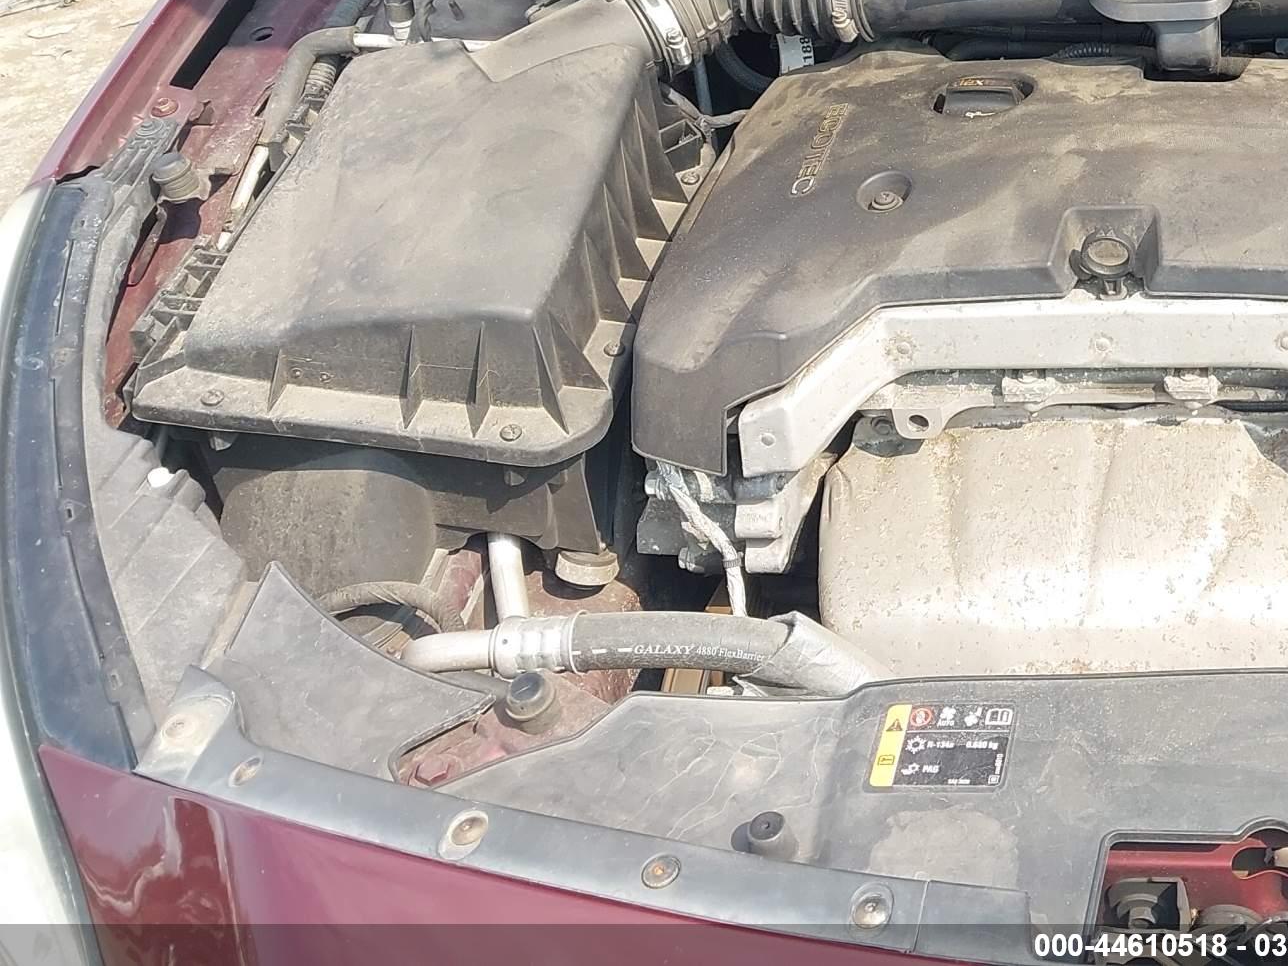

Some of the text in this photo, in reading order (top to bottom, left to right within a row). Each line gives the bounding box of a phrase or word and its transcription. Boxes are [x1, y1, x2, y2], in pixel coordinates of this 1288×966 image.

[799, 36, 814, 67] 188
[789, 103, 849, 196] ECOTEC
[633, 643, 694, 655] GALAXY
[696, 645, 717, 656] 4880
